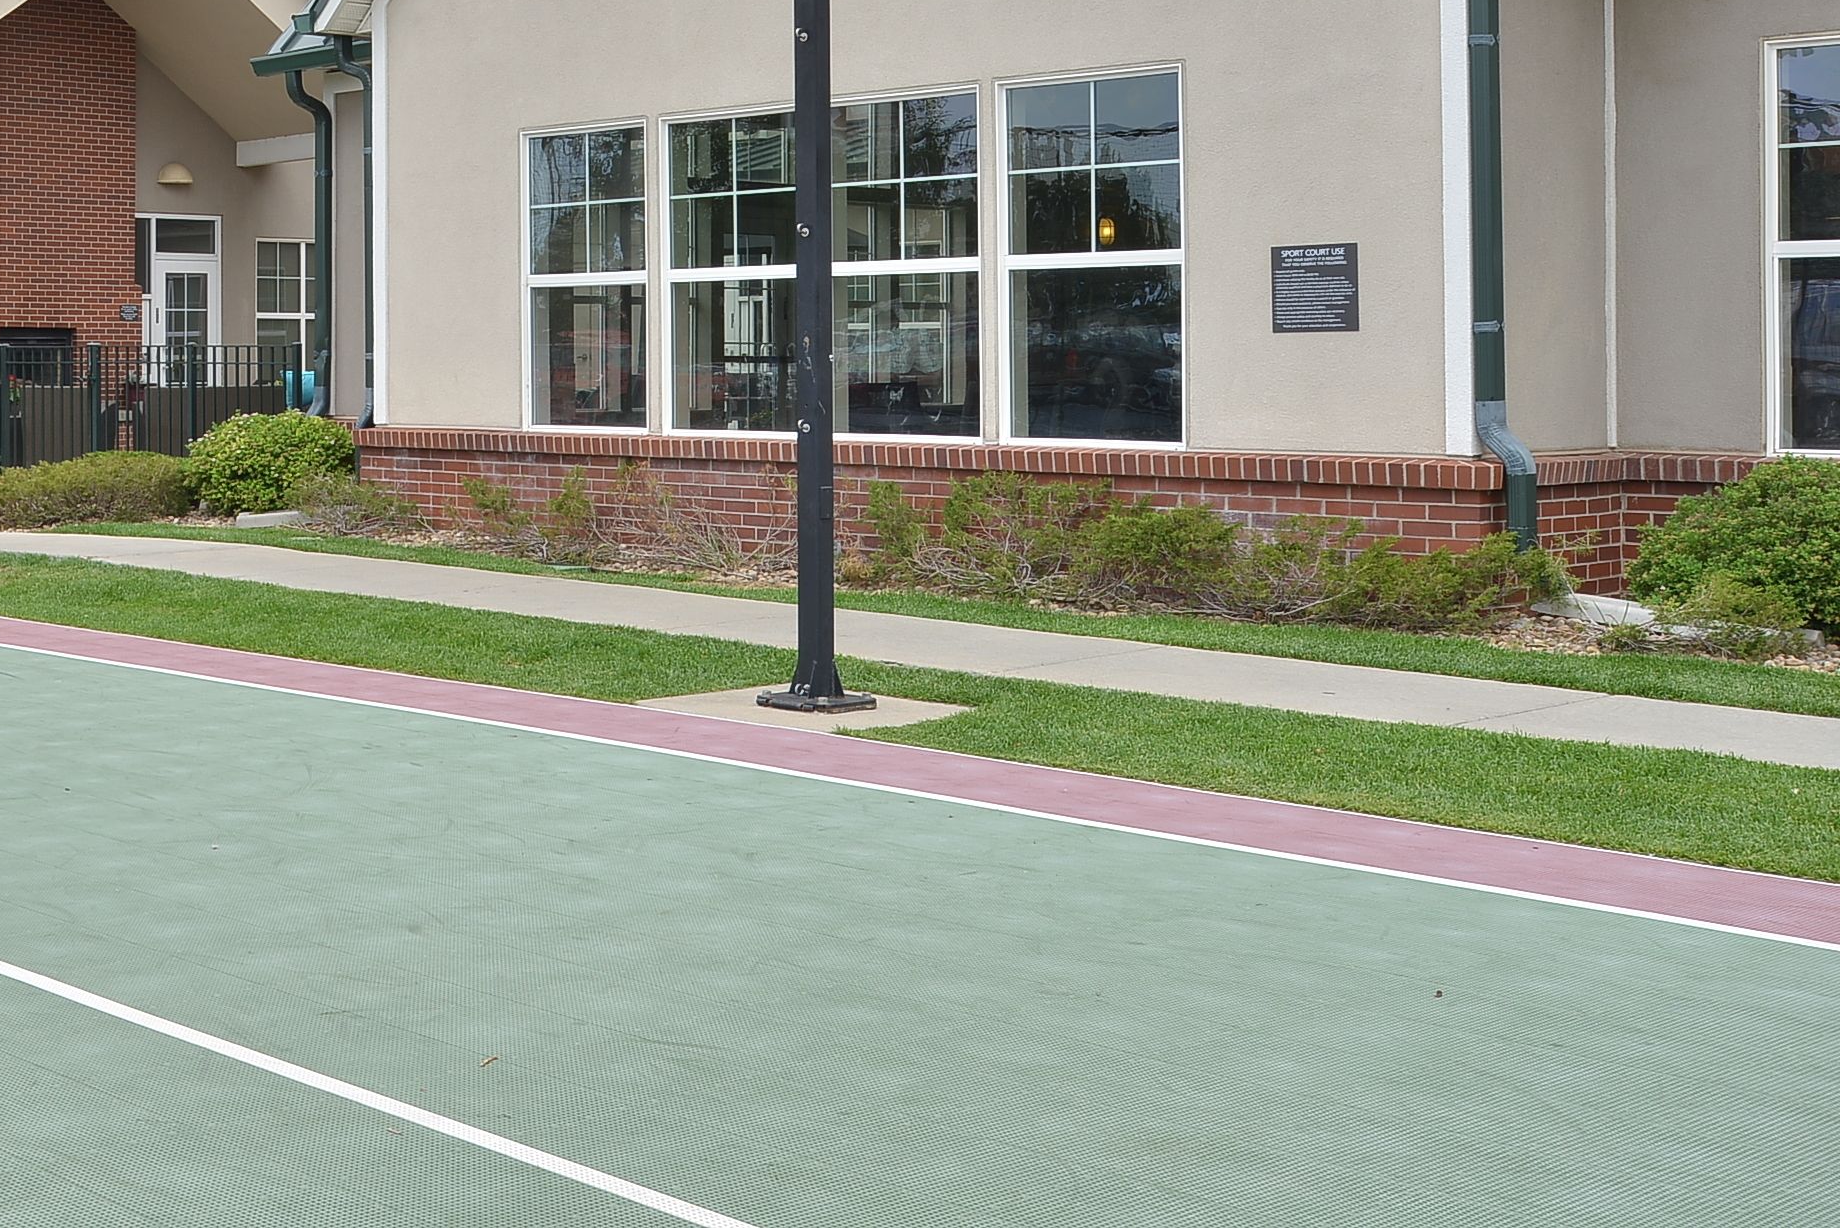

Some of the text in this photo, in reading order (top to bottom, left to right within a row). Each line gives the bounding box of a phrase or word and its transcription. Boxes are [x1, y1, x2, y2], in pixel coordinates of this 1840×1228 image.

[1281, 247, 1345, 258] SPORT COURT USE
